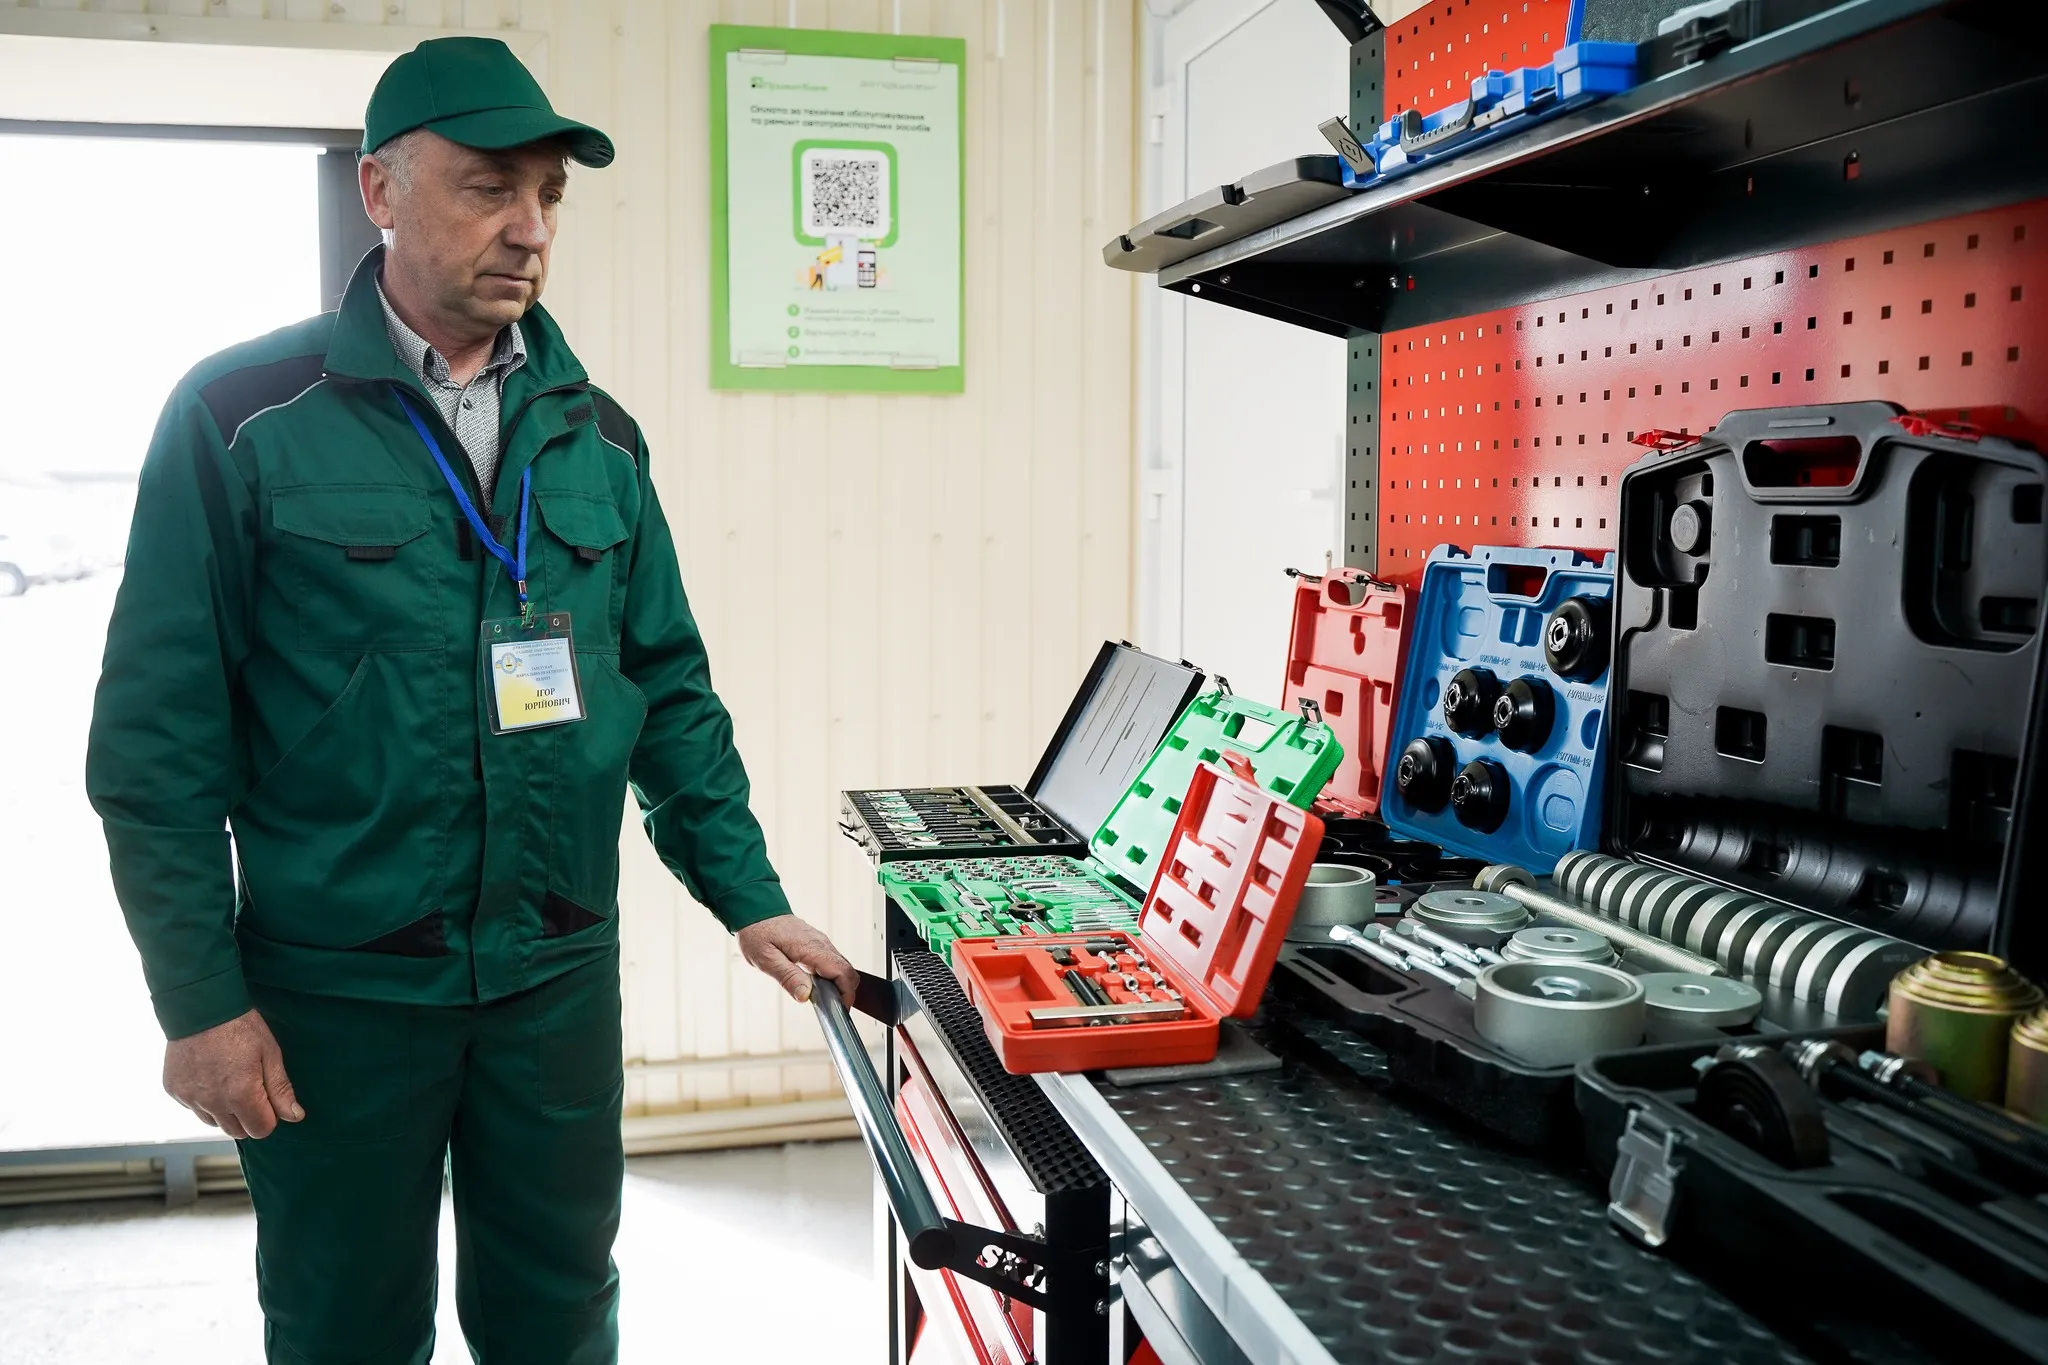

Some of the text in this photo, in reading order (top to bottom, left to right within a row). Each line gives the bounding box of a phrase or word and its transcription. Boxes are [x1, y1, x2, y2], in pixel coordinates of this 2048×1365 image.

[750, 105, 788, 115] Оплата
[536, 688, 556, 697] ІГОР
[524, 698, 570, 711] ЮРІЙОВИЧ
